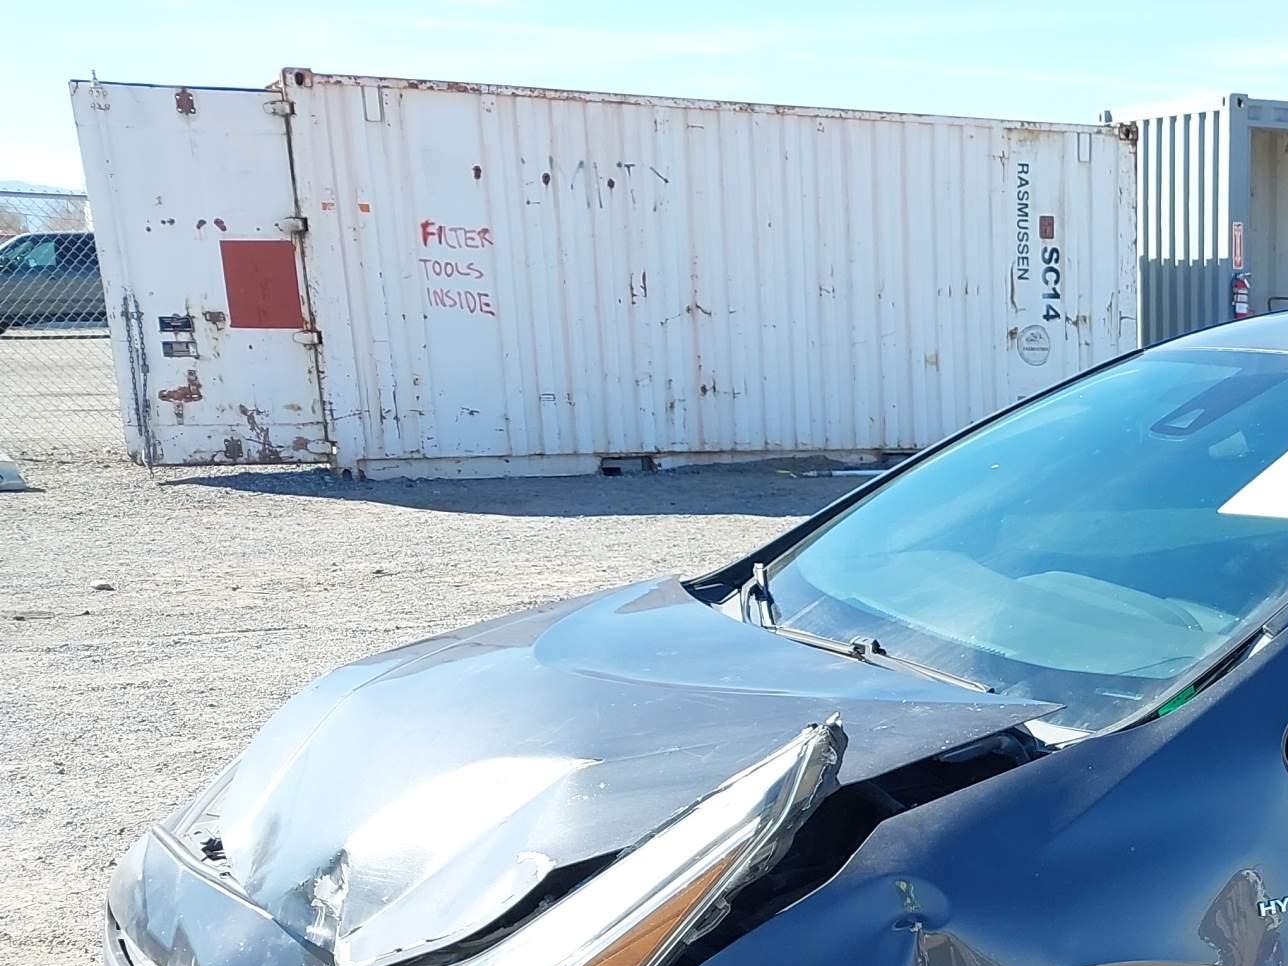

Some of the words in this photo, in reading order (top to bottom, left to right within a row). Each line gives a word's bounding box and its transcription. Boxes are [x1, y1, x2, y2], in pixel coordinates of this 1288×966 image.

[420, 219, 494, 249] FILTER
[1016, 162, 1030, 281] RASMUSSEN
[418, 258, 484, 281] TOOLS
[1040, 246, 1062, 323] SC14
[426, 287, 496, 317] INSIDE
